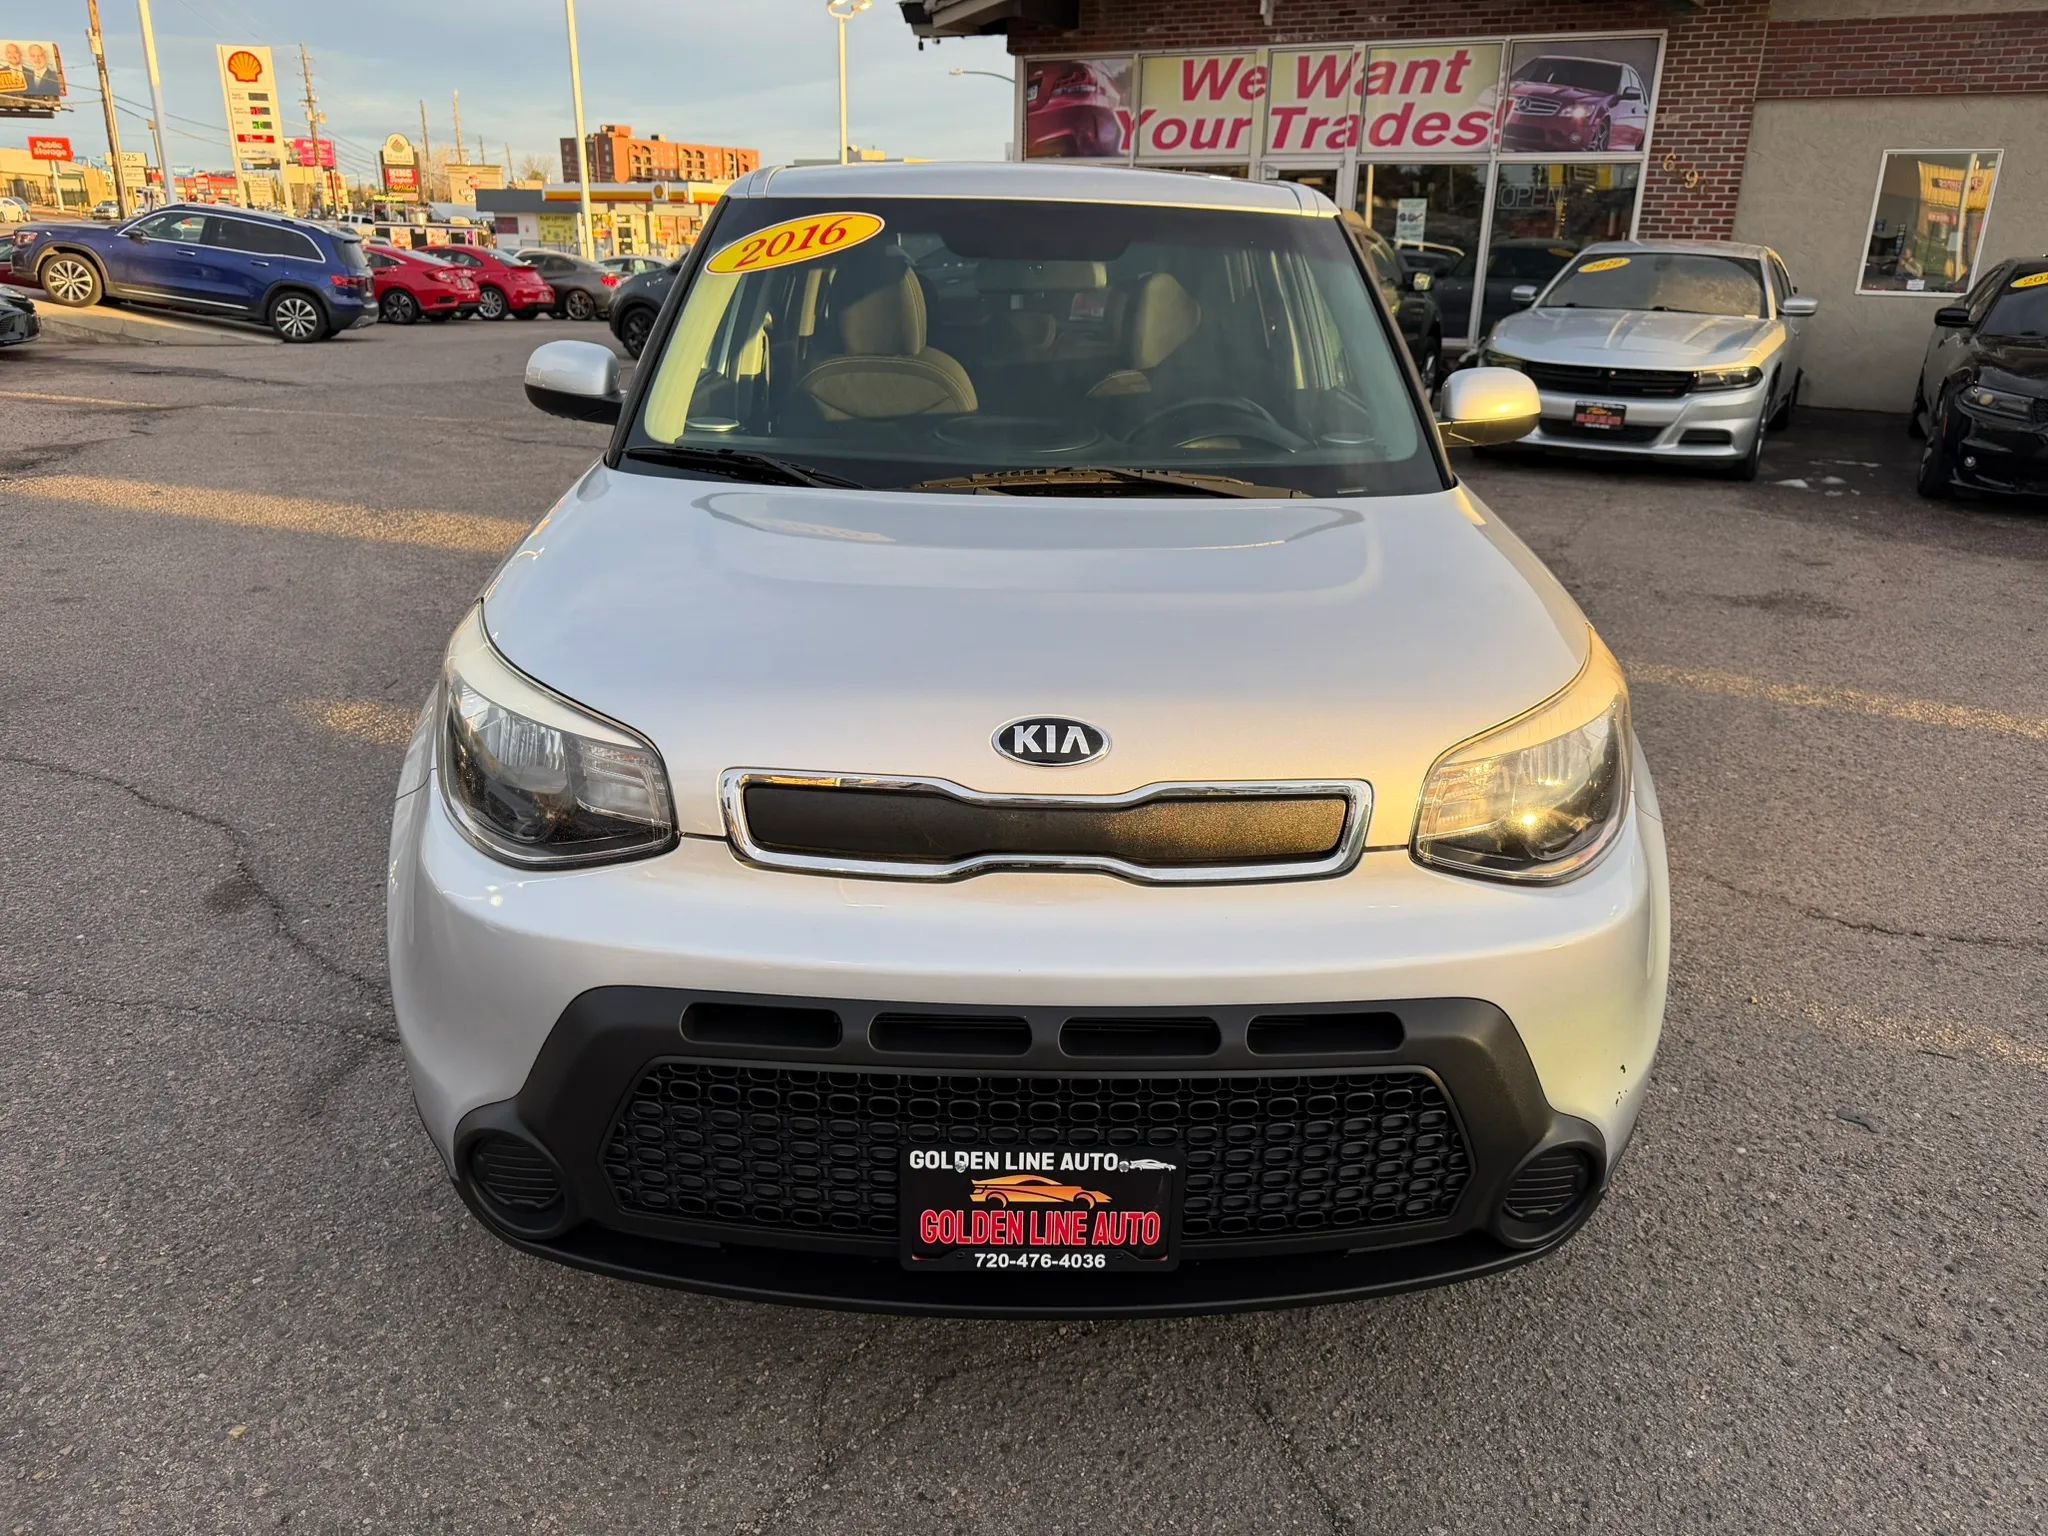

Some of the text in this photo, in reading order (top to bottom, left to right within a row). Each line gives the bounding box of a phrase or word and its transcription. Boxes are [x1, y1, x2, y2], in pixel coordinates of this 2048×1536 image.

[1182, 49, 1472, 102] We Want
[1114, 99, 1515, 150] Your Trades!
[36, 141, 62, 149] Public
[1501, 185, 1566, 207] OPEN
[733, 216, 853, 268] 2016
[1013, 724, 1090, 755] KIA
[909, 1150, 1119, 1172] GOLDEN LINE AUTO
[920, 1209, 1161, 1246] GOLDEN LINE AUTO
[974, 1253, 1106, 1269] 720-476-4036
